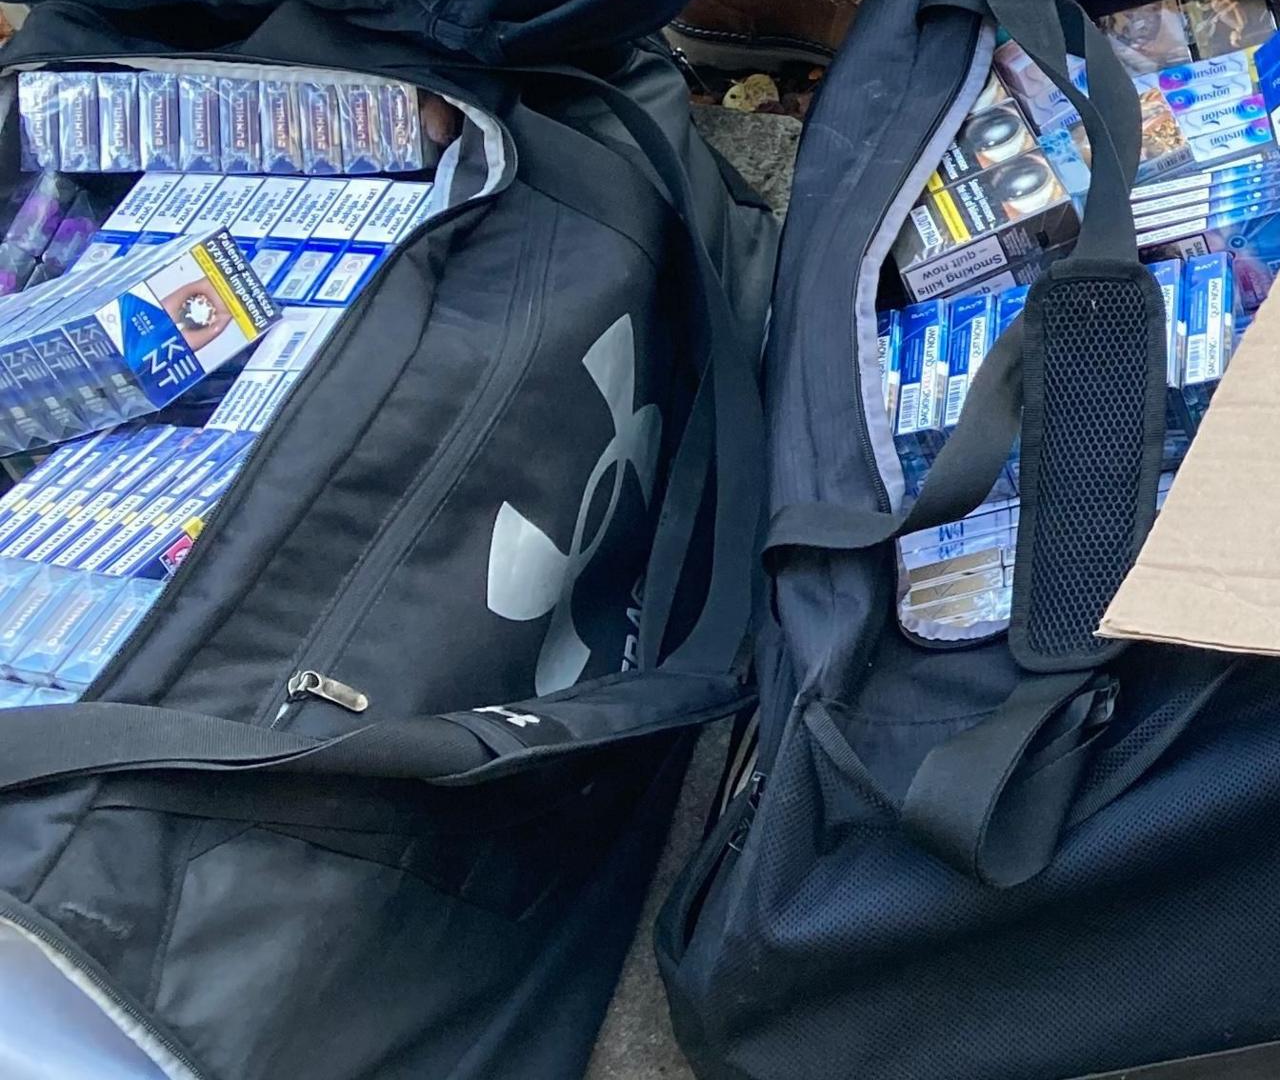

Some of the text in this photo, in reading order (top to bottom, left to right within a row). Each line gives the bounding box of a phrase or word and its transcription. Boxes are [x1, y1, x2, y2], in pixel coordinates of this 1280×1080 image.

[155, 95, 164, 147] DUNHILL
[236, 96, 245, 149] DUNHILL
[277, 96, 286, 149] DUNHILL
[1201, 104, 1245, 122] Winston
[118, 186, 146, 216] Palenie
[150, 181, 173, 204] teraz!
[158, 187, 187, 216] Palenie
[190, 182, 214, 206] teraz!
[200, 191, 228, 220] Palenie
[241, 192, 269, 221] Palenie
[273, 187, 295, 210] teraz!
[317, 188, 338, 212] teraz!
[357, 188, 378, 212] teraz!
[400, 192, 421, 215] teraz!
[284, 193, 312, 222] Palenie
[327, 194, 353, 223] Palenie
[368, 197, 395, 226] Palenie
[218, 232, 274, 317] Palenie zwiększa
[917, 253, 1003, 295] Smoking kills
[922, 250, 976, 280] quit now
[207, 241, 267, 328] ryzyko impotencji
[111, 502, 198, 573] Fumatul ucide
